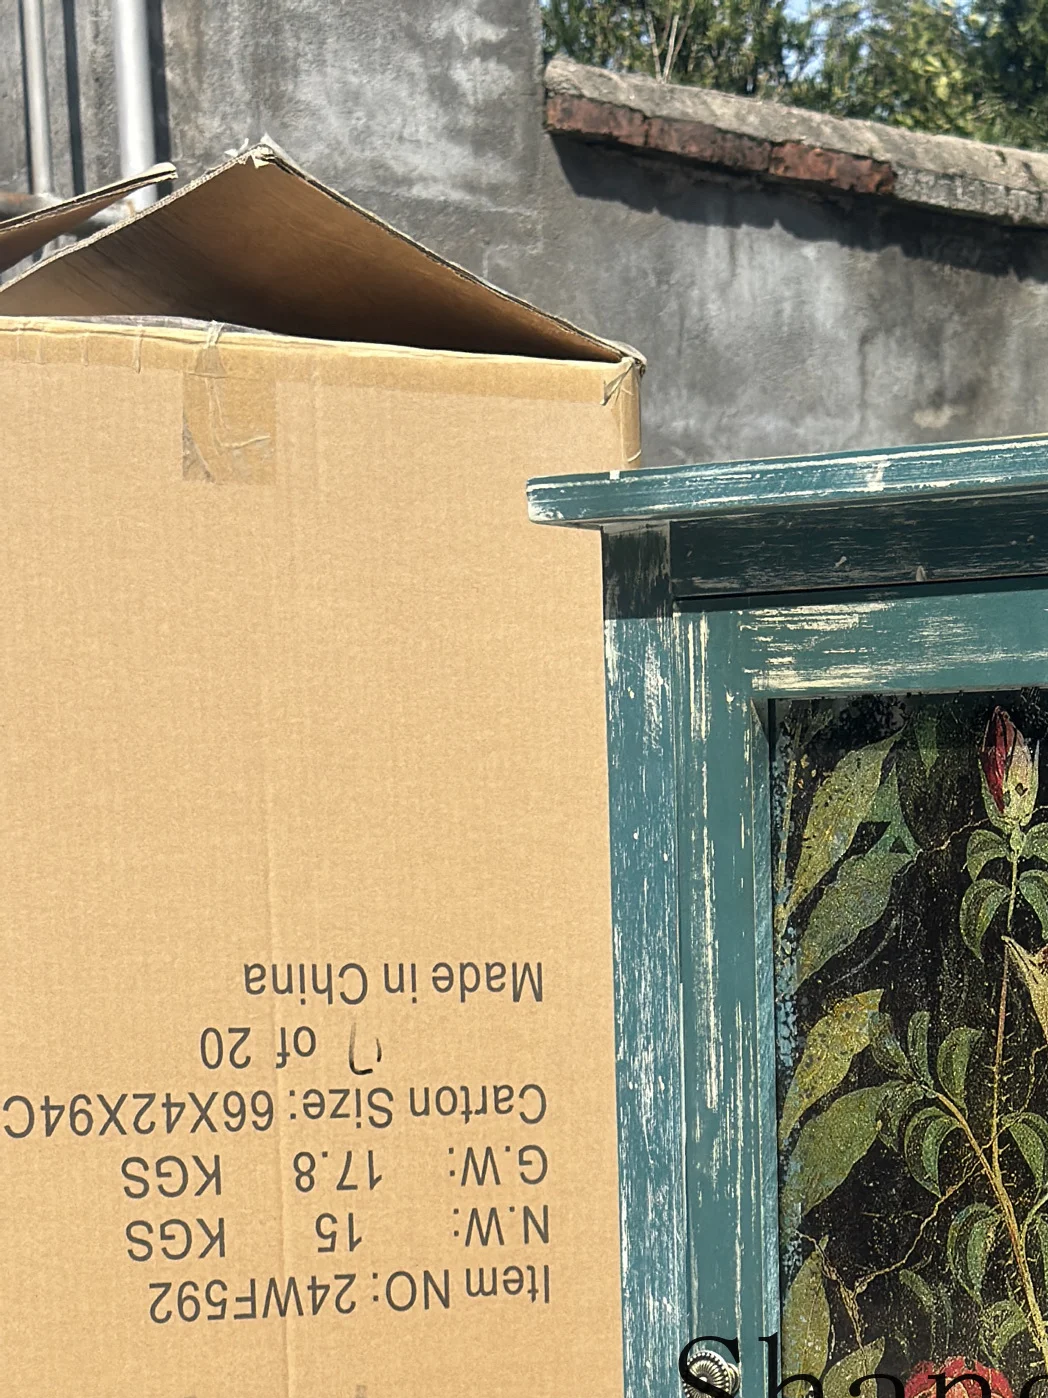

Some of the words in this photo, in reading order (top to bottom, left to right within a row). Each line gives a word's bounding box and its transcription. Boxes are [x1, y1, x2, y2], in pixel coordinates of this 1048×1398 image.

[243, 962, 368, 1005] China
[383, 963, 417, 1004] in
[431, 961, 543, 1003] Made
[200, 1027, 251, 1070] 20
[276, 1025, 316, 1069] of
[2, 1090, 274, 1139] 66X42X94C
[289, 1087, 394, 1129] Size:
[409, 1083, 547, 1124] Carton
[121, 1154, 222, 1199] KGS
[293, 1150, 382, 1193] 17.8
[448, 1144, 548, 1187] G.W:
[125, 1217, 226, 1262] KGS
[315, 1212, 362, 1253] 15
[453, 1204, 549, 1247] N.W:
[149, 1273, 357, 1324] 24WF592
[372, 1269, 450, 1312] NO:
[465, 1264, 550, 1304] Item
